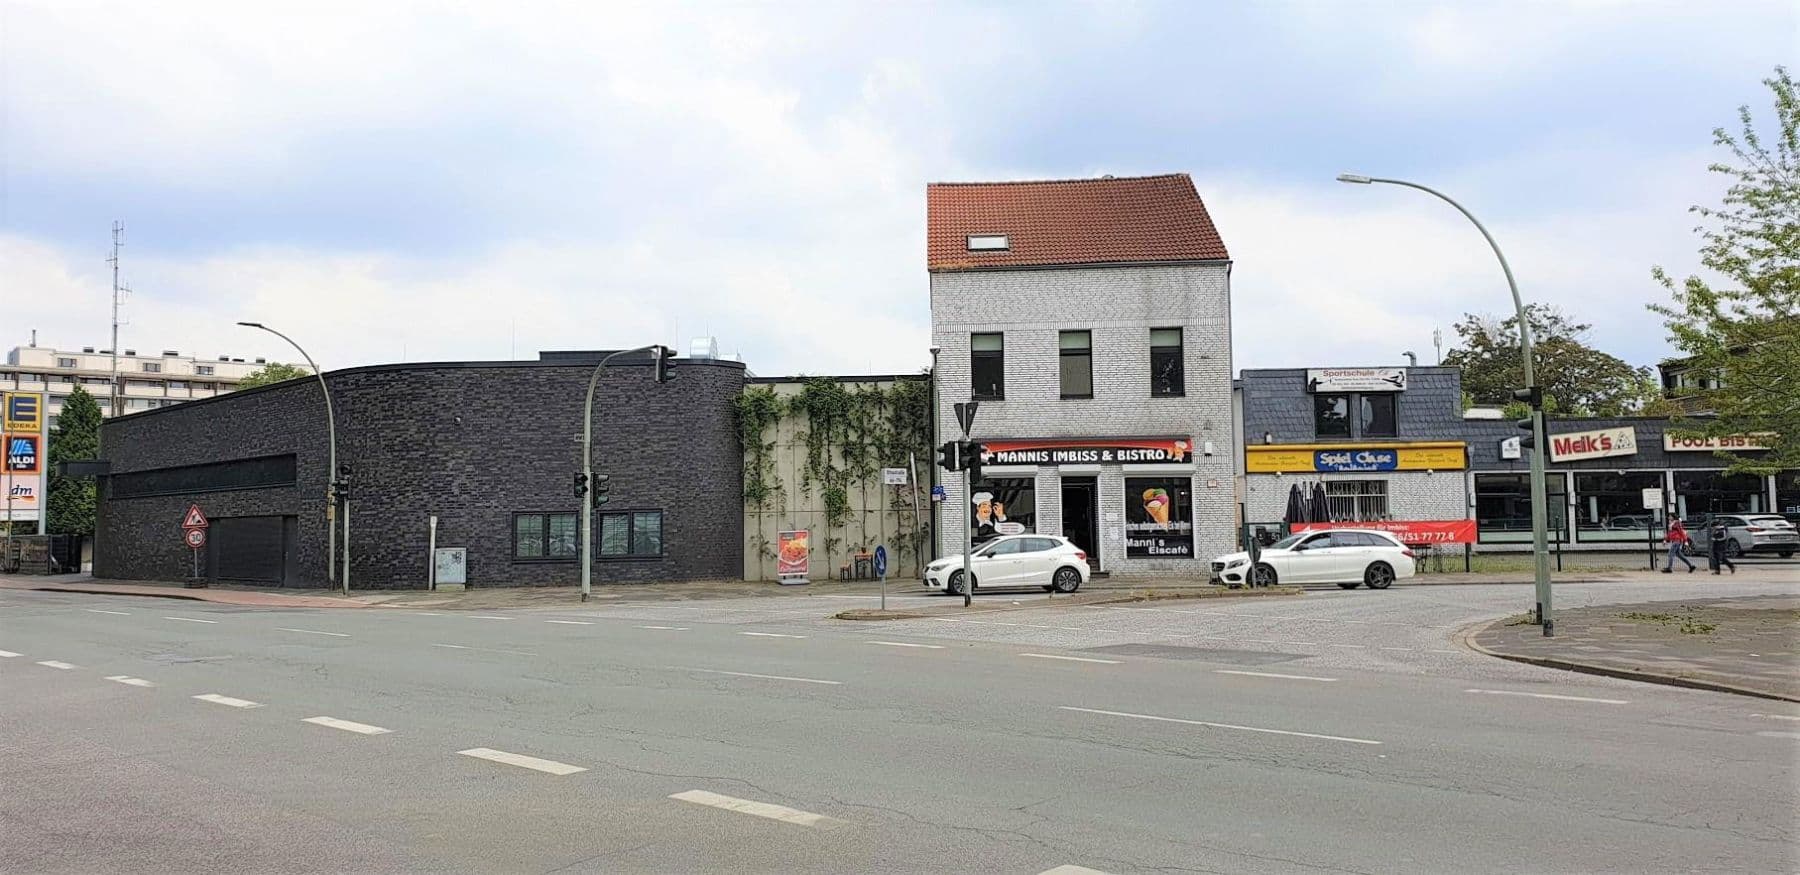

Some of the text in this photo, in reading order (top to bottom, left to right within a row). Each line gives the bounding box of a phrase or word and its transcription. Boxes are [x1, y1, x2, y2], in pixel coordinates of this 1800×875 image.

[1322, 369, 1375, 378] Sportschule
[8, 455, 34, 464] ALDI
[996, 448, 1165, 463] MANNIS IMBISS & BISTRO
[11, 484, 32, 496] dm
[191, 533, 201, 543] 30
